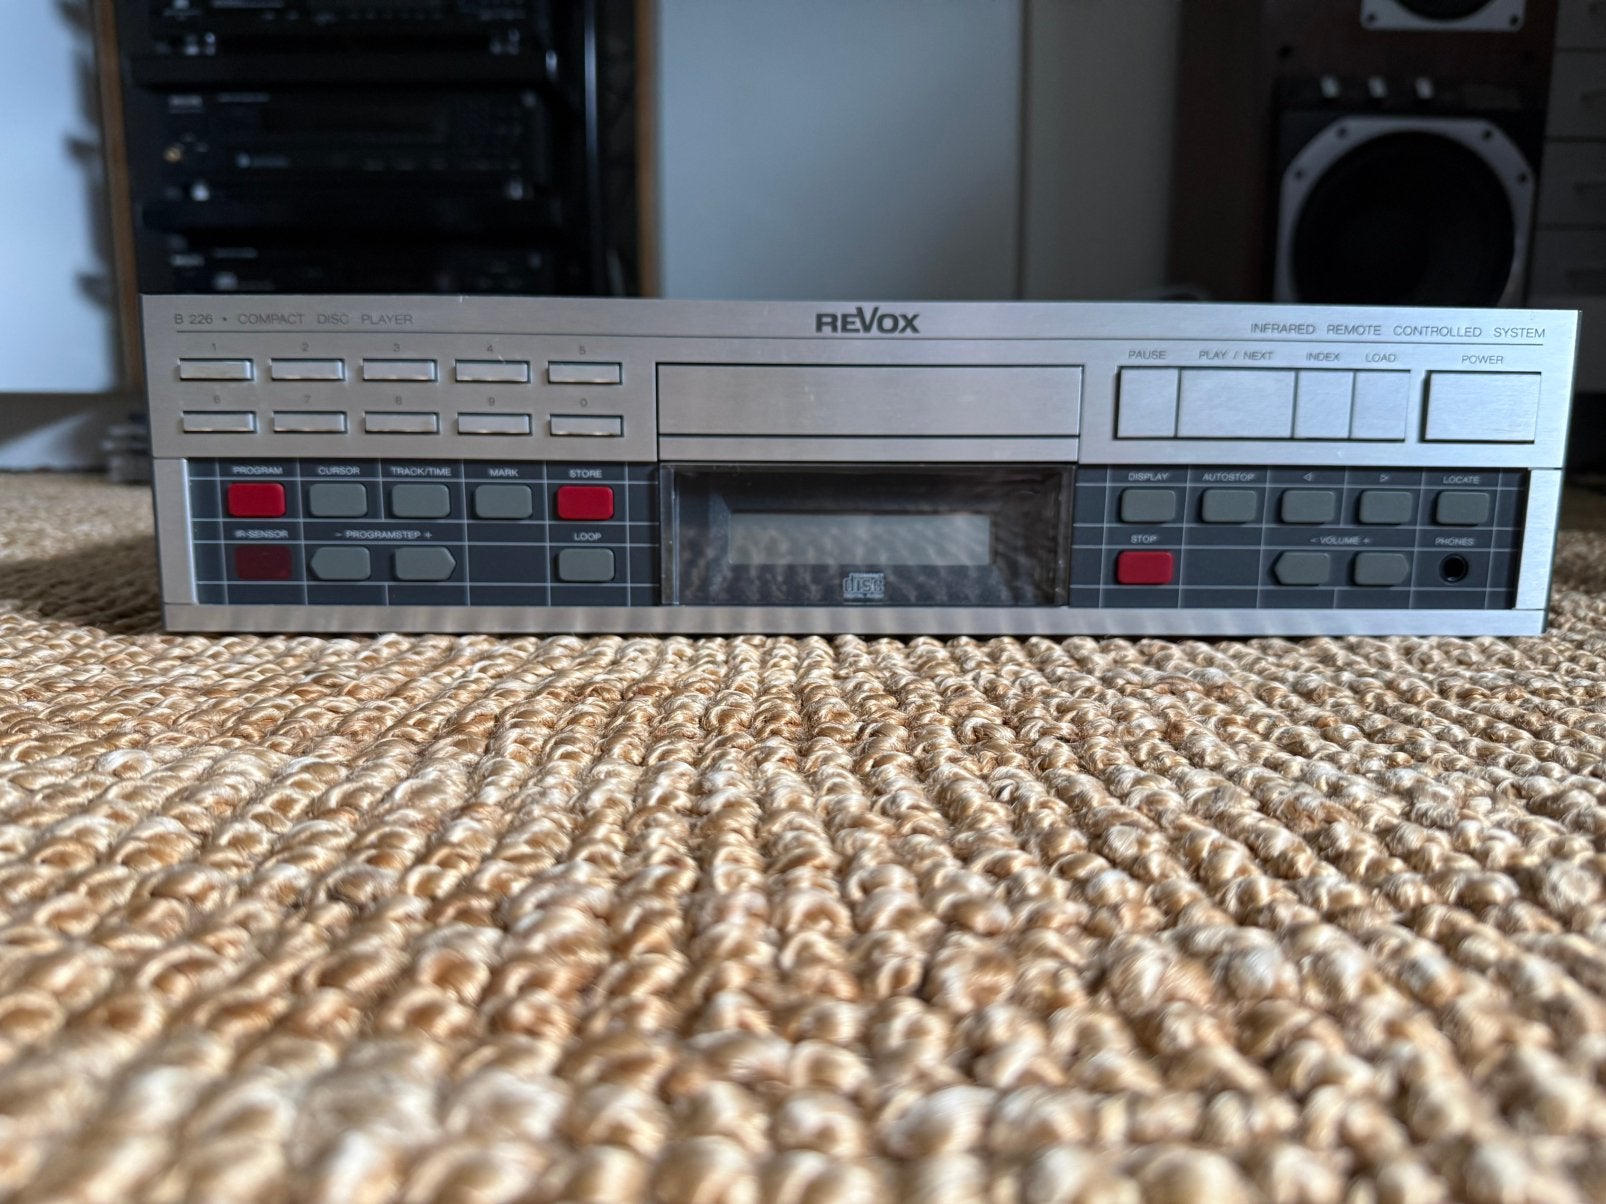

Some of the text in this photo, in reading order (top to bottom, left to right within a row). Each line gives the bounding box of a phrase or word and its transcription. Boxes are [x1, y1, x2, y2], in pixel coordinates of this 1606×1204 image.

[175, 313, 413, 326] B 226 COMPACT DISC PLAYER
[1251, 323, 1546, 339] INFRARED REMOTE CONTROLLED SYSTEM
[302, 343, 309, 352] 2
[393, 343, 400, 352] 3
[487, 345, 493, 353] 4
[579, 346, 586, 355] 5
[1128, 350, 1167, 361] PAUSE
[1199, 351, 1229, 361] PLAY
[1243, 351, 1274, 361] NEXT
[1306, 352, 1341, 362] INDEX
[1365, 353, 1397, 363] LOAD
[1461, 355, 1504, 365] POWER
[304, 395, 312, 405] 7
[488, 397, 496, 407] 9
[232, 466, 284, 475] PROGRAM
[318, 466, 361, 476] CURSOR
[390, 467, 452, 477] TRACK/TIME
[489, 468, 519, 477] MARK
[569, 469, 603, 479] STORE
[1128, 472, 1170, 481] DISPLAY
[1202, 472, 1255, 481] AUTOSTOP
[1442, 475, 1481, 485] LOCATE
[234, 529, 289, 539] IR-SENSOR
[345, 530, 421, 540] PROGRAMSTEP
[573, 532, 602, 542] LOOP
[1130, 535, 1159, 544] STOP
[1320, 536, 1362, 545] VOLUME
[1435, 537, 1476, 546] PHONES
